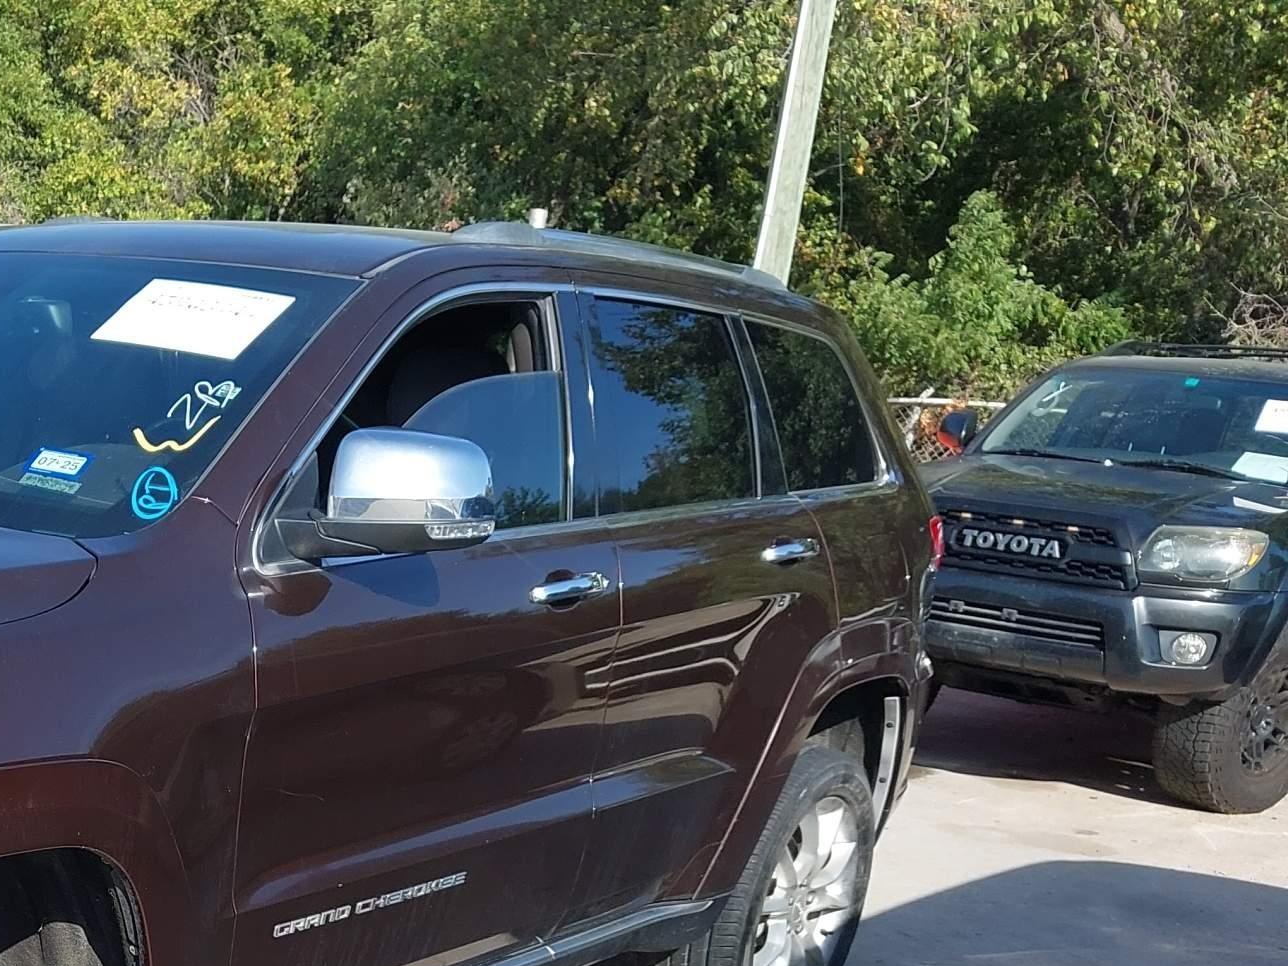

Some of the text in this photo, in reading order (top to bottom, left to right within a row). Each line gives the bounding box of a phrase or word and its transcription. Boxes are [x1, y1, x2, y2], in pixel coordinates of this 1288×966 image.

[962, 528, 1061, 559] TOYOTA
[273, 871, 468, 938] GRAND CHEROKEE
